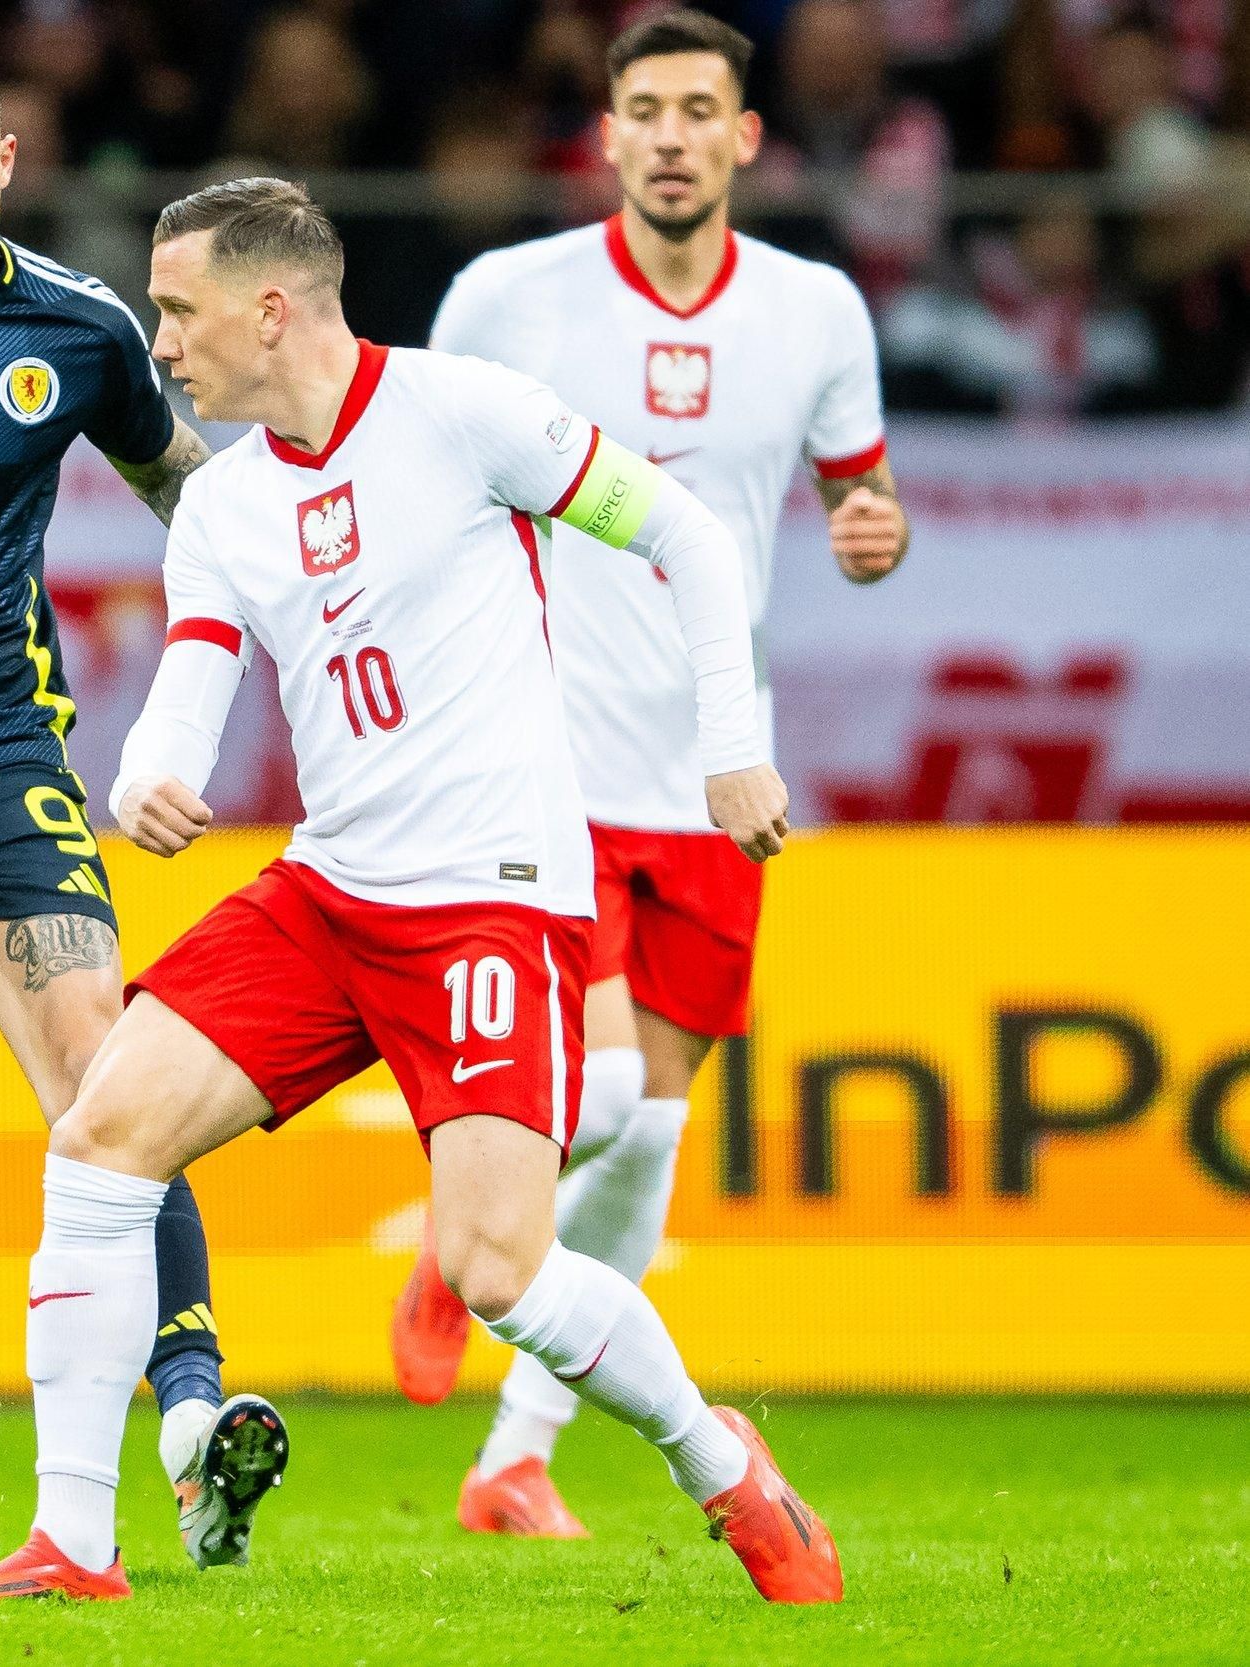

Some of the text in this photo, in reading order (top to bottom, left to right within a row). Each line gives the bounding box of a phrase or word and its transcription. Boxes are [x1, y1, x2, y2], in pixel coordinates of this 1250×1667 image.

[587, 477, 628, 536] RESPECT
[326, 646, 408, 740] 10
[24, 785, 99, 857] 9
[444, 955, 516, 1043] 10
